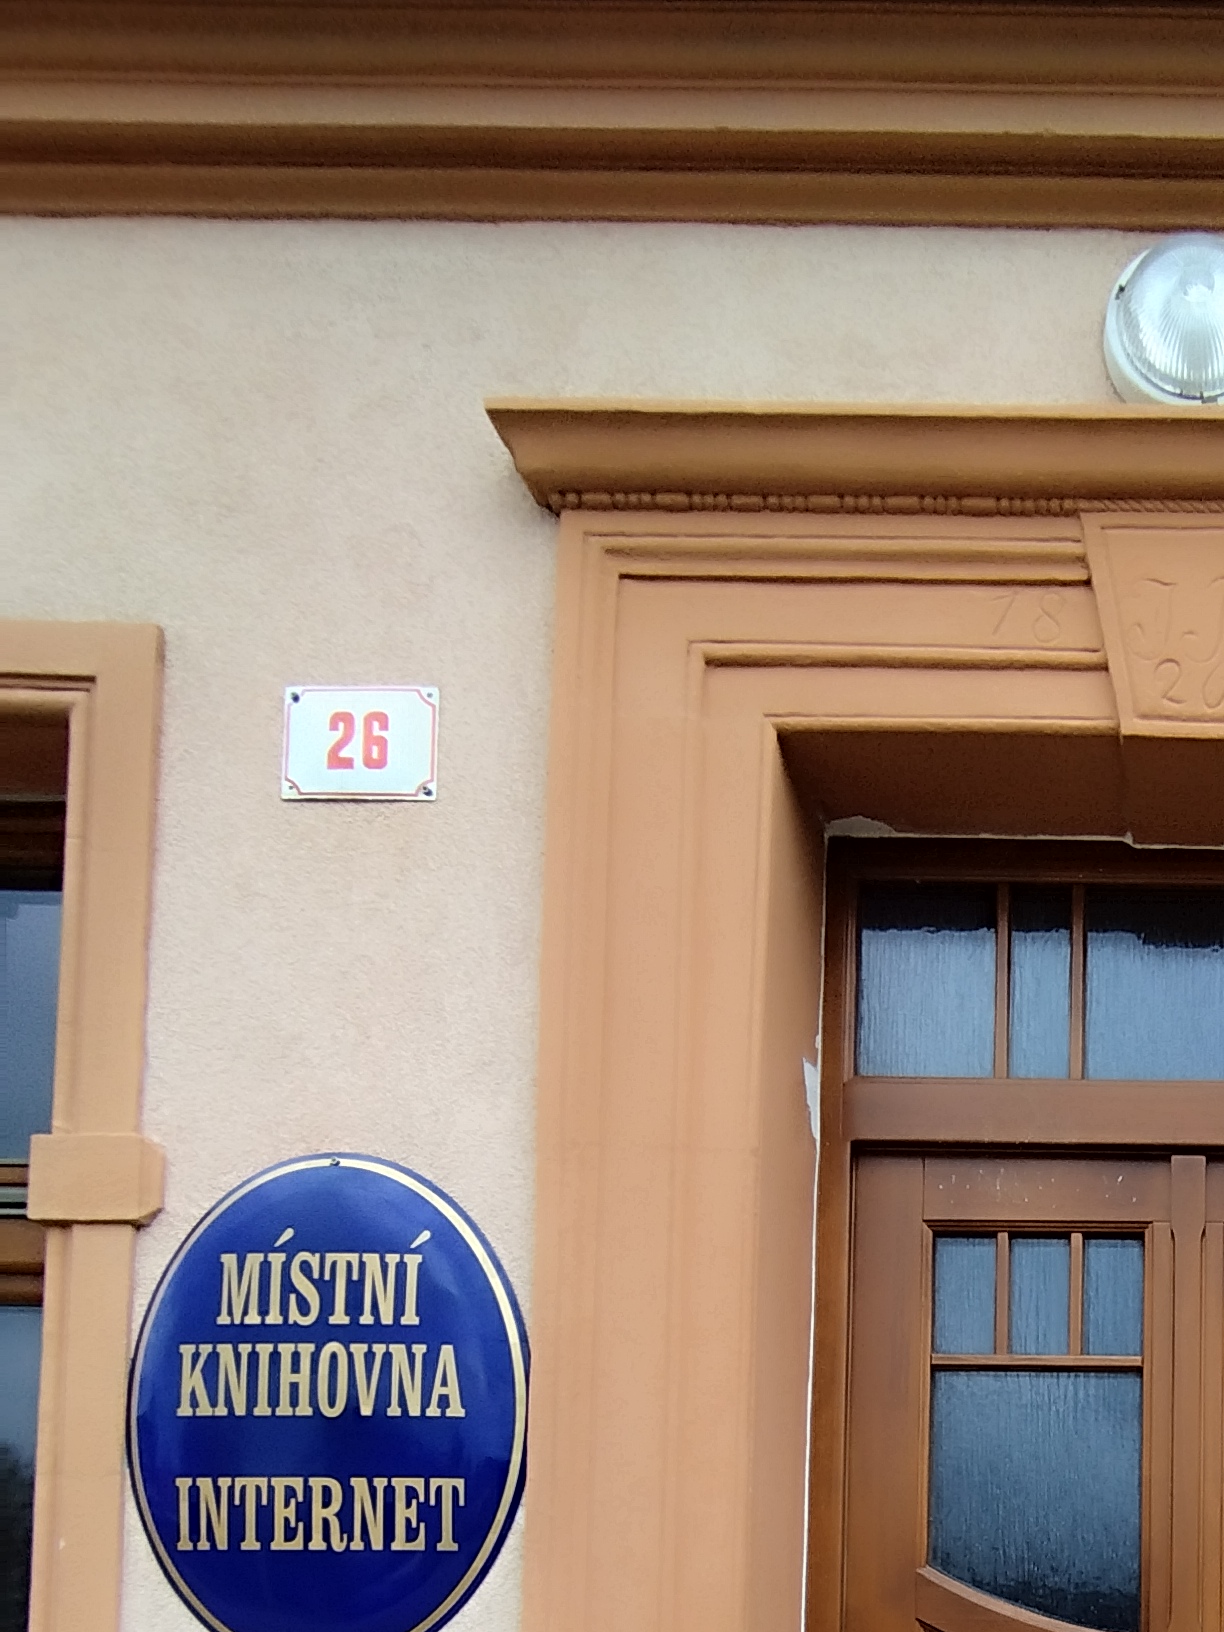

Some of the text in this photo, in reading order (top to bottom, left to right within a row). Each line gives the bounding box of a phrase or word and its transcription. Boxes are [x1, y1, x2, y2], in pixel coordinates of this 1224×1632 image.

[327, 711, 390, 770] 26
[216, 1227, 431, 1326] MÍSTNÍ
[176, 1341, 466, 1418] KNIHOVNA
[175, 1477, 466, 1553] INTERNET
